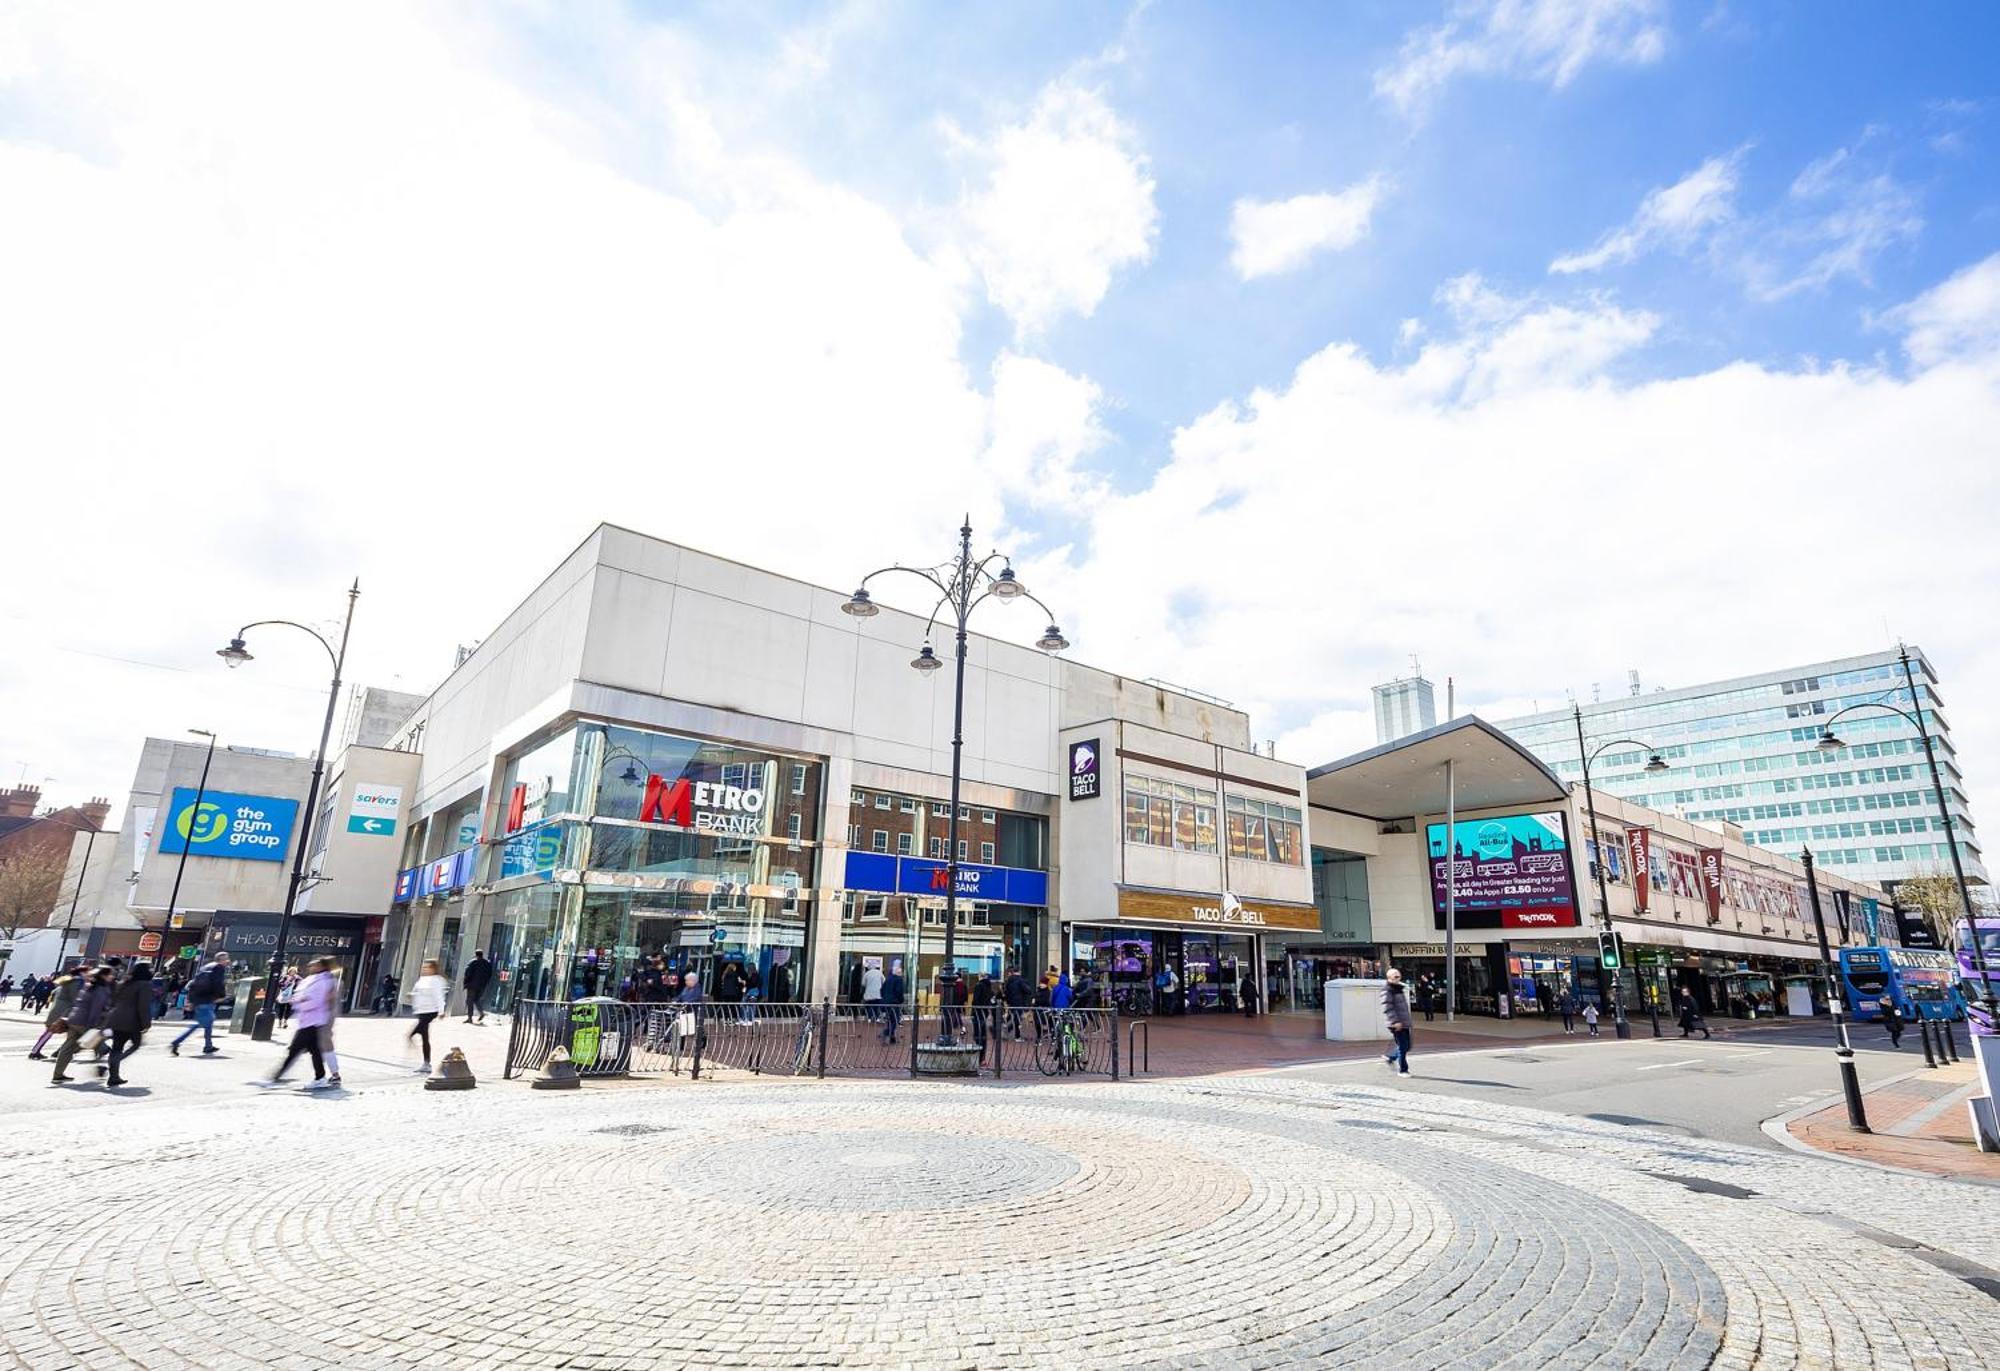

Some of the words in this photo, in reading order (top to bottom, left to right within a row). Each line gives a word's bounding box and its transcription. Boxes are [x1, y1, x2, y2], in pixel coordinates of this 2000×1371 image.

[1072, 773, 1096, 786] TACO
[1073, 784, 1096, 797] BELL
[356, 794, 398, 806] savers
[640, 774, 763, 828] METRO
[237, 807, 264, 820] the
[233, 819, 272, 835] gym
[695, 811, 761, 834] BANK
[229, 833, 280, 848] group
[1703, 855, 1720, 888] wilko
[1541, 875, 1552, 883] for
[1504, 885, 1532, 895] £3.50
[1192, 906, 1220, 921] TACO
[1241, 910, 1266, 925] BELL
[1400, 945, 1436, 955] MUFFIN
